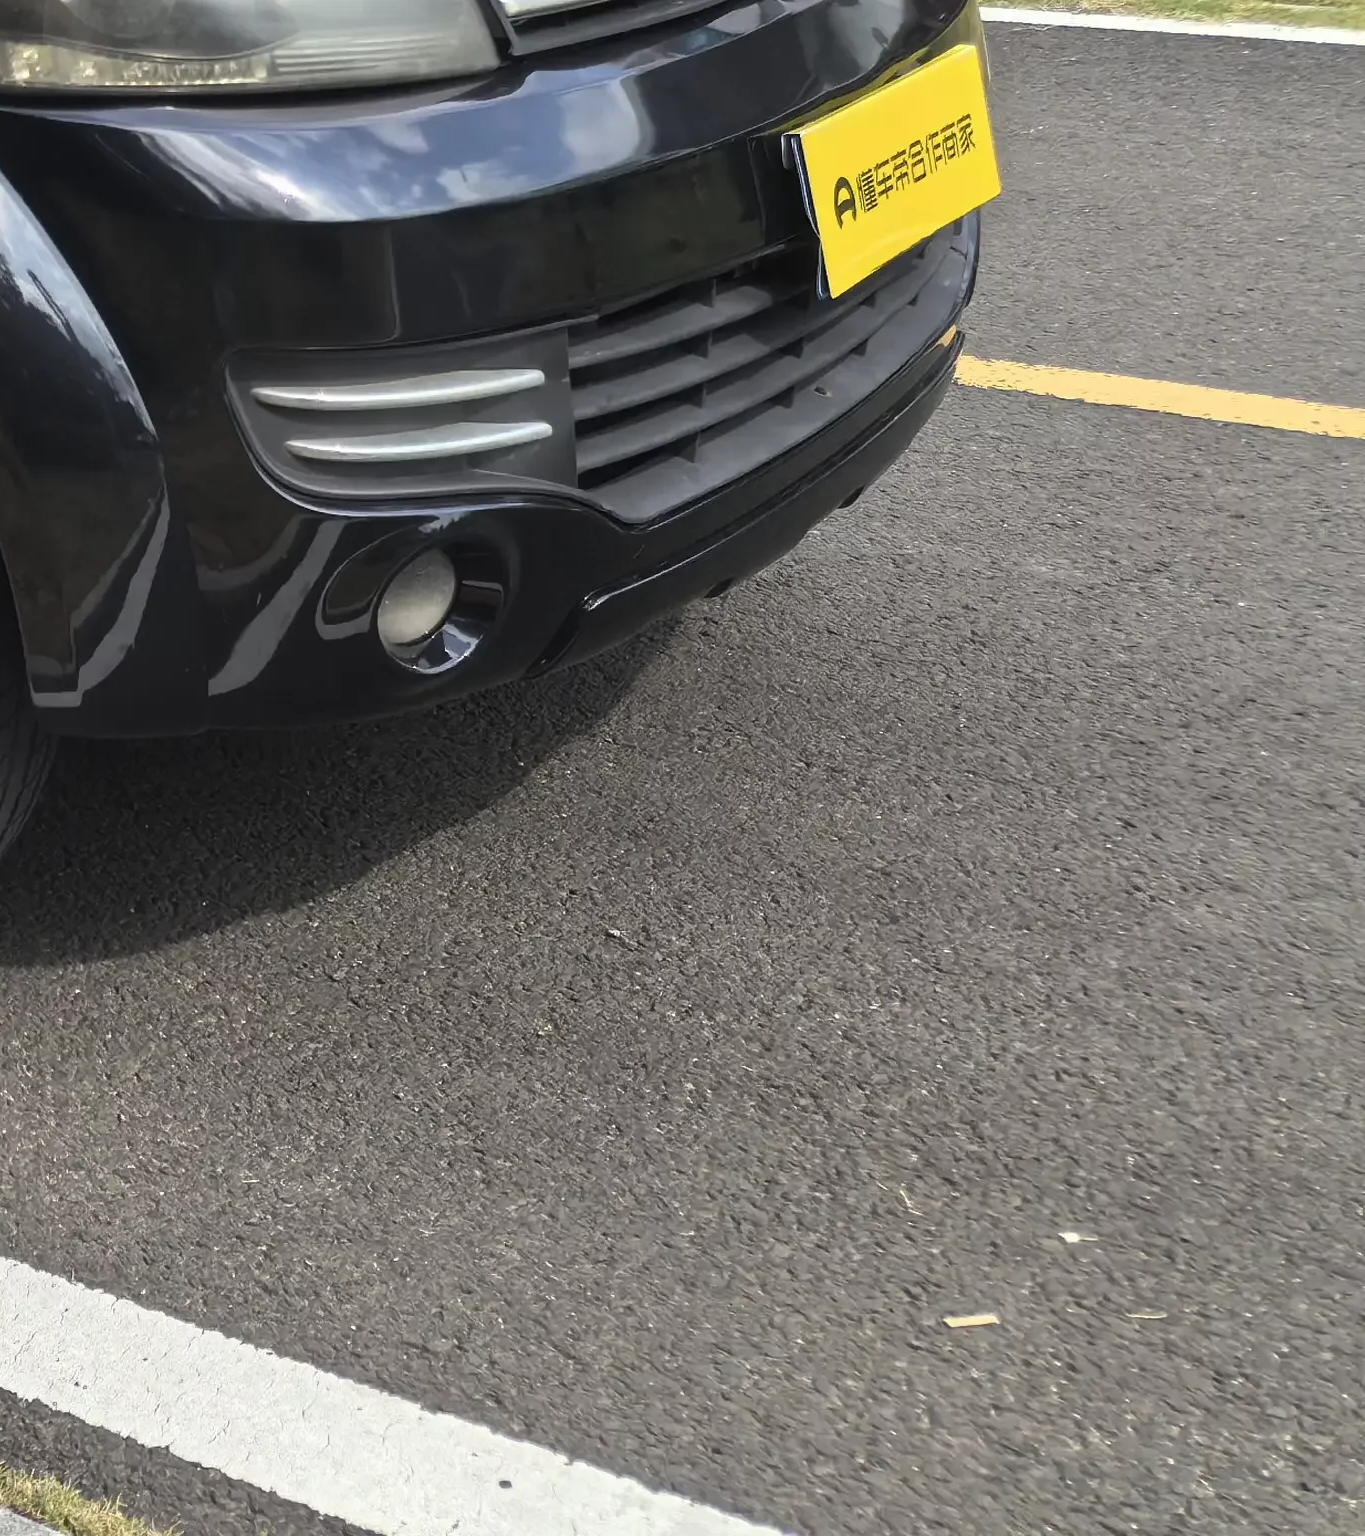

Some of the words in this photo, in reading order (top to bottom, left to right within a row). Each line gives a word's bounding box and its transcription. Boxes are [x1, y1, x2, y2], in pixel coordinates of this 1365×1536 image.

[855, 113, 976, 213] 懂车帝合作商家
